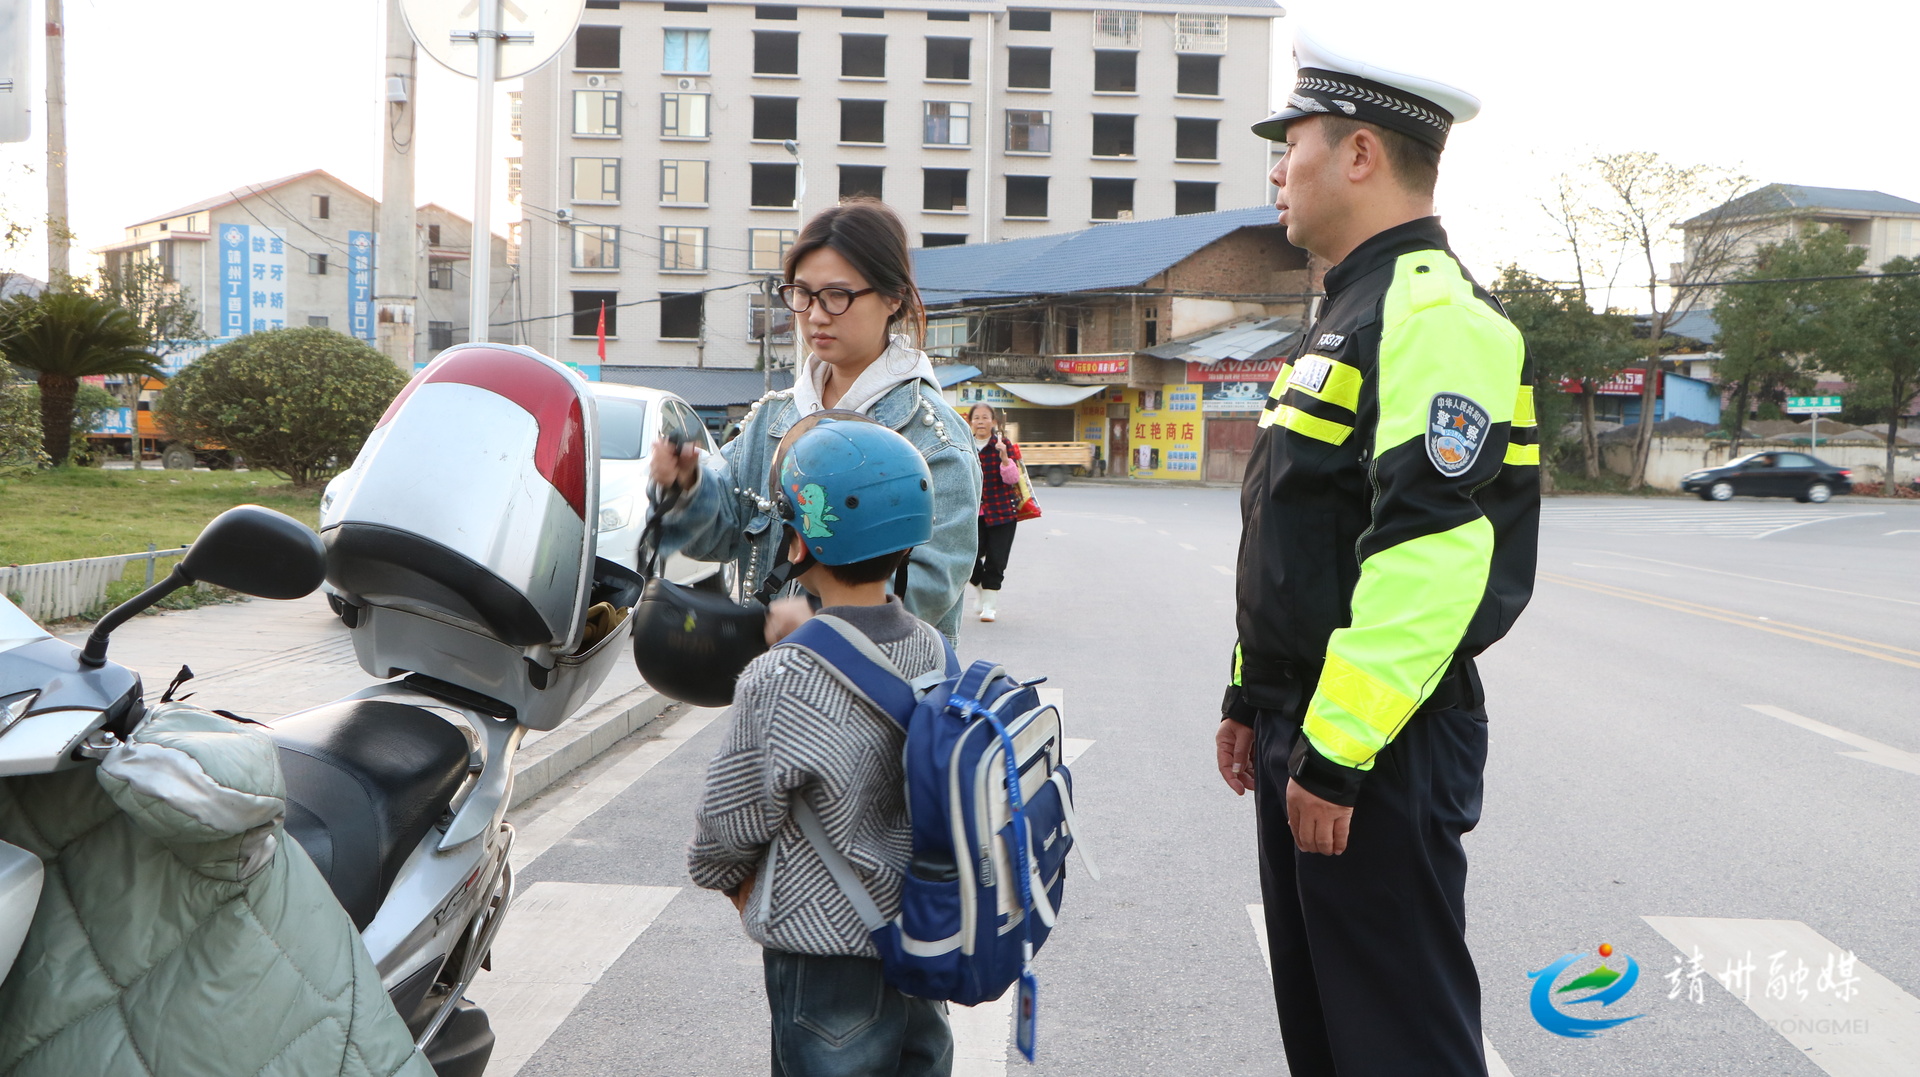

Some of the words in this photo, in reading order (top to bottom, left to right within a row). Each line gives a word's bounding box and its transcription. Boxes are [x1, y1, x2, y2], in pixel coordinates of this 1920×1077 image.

[1437, 397, 1486, 428] 中华人民共和国
[1135, 422, 1194, 440] 红艳商店
[1445, 429, 1467, 443] POLICE
